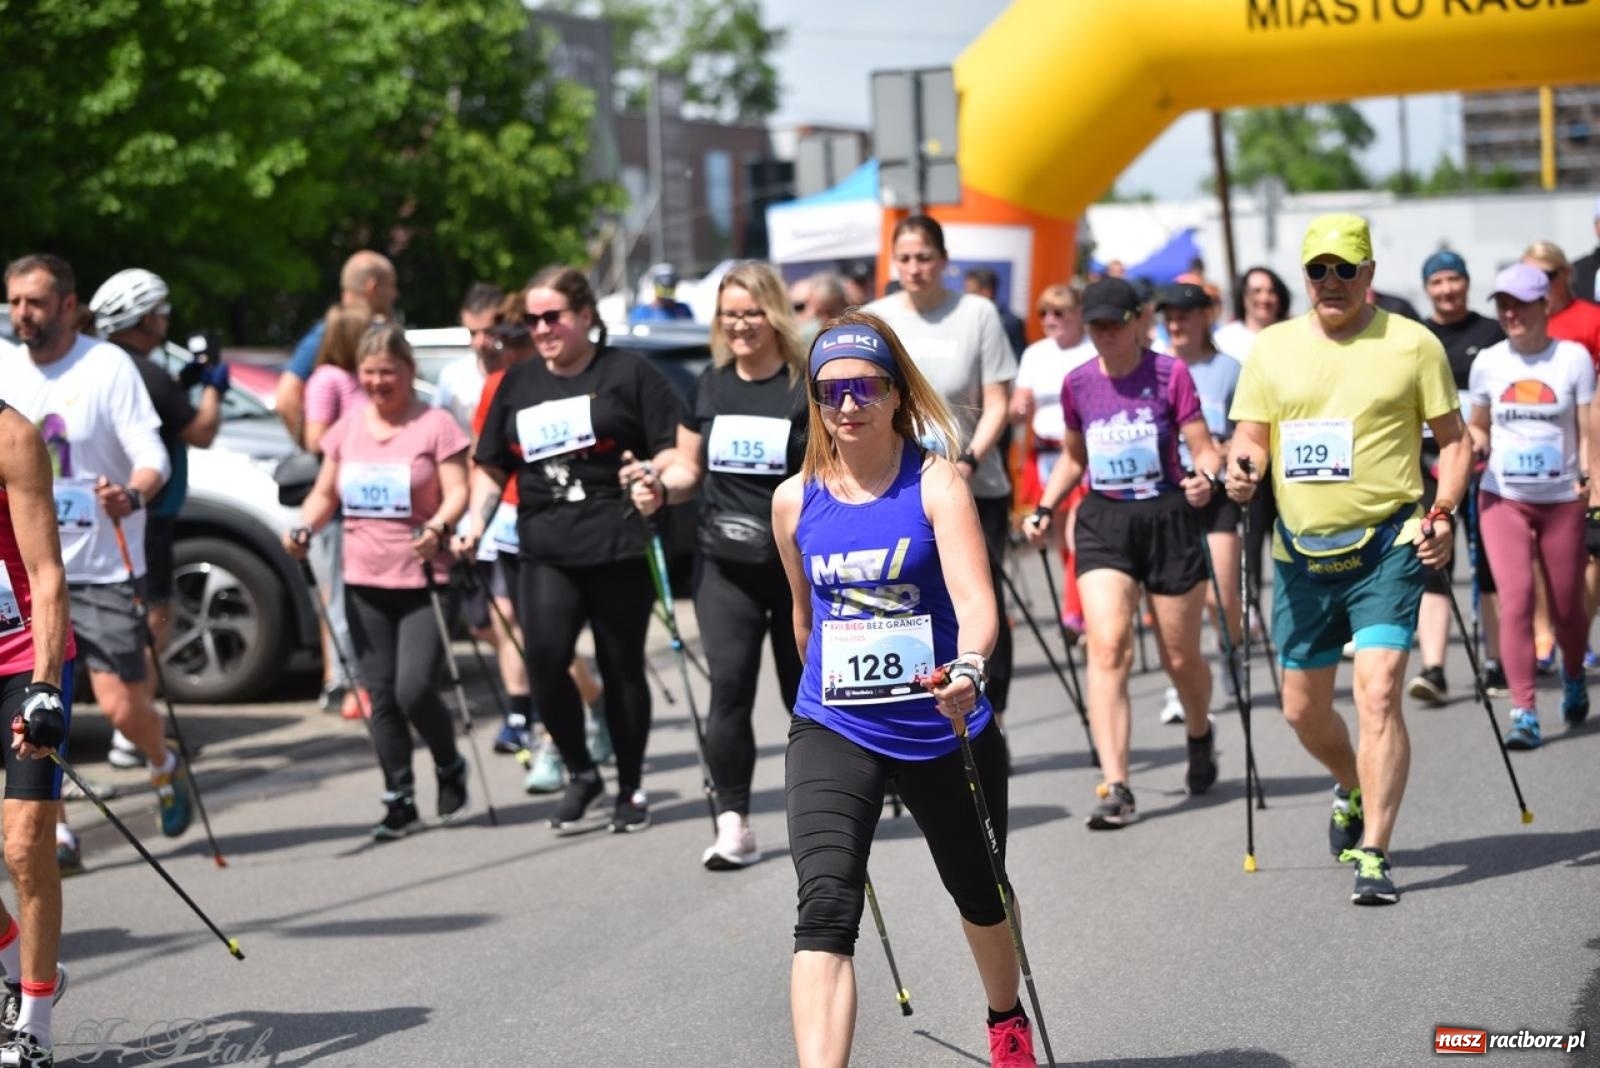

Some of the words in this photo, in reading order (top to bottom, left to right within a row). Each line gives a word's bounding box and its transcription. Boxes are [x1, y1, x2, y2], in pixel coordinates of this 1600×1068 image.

[822, 333, 878, 350] LEKI
[541, 421, 570, 440] 132
[731, 440, 765, 459] 135
[1295, 444, 1329, 464] 129
[1109, 458, 1138, 475] 113
[1518, 453, 1545, 470] 115
[361, 485, 389, 502] 101
[1307, 556, 1363, 574] Reebok
[845, 622, 865, 631] BIEG
[866, 621, 884, 630] BEZ
[885, 618, 923, 630] GRANIC
[848, 652, 904, 681] 128
